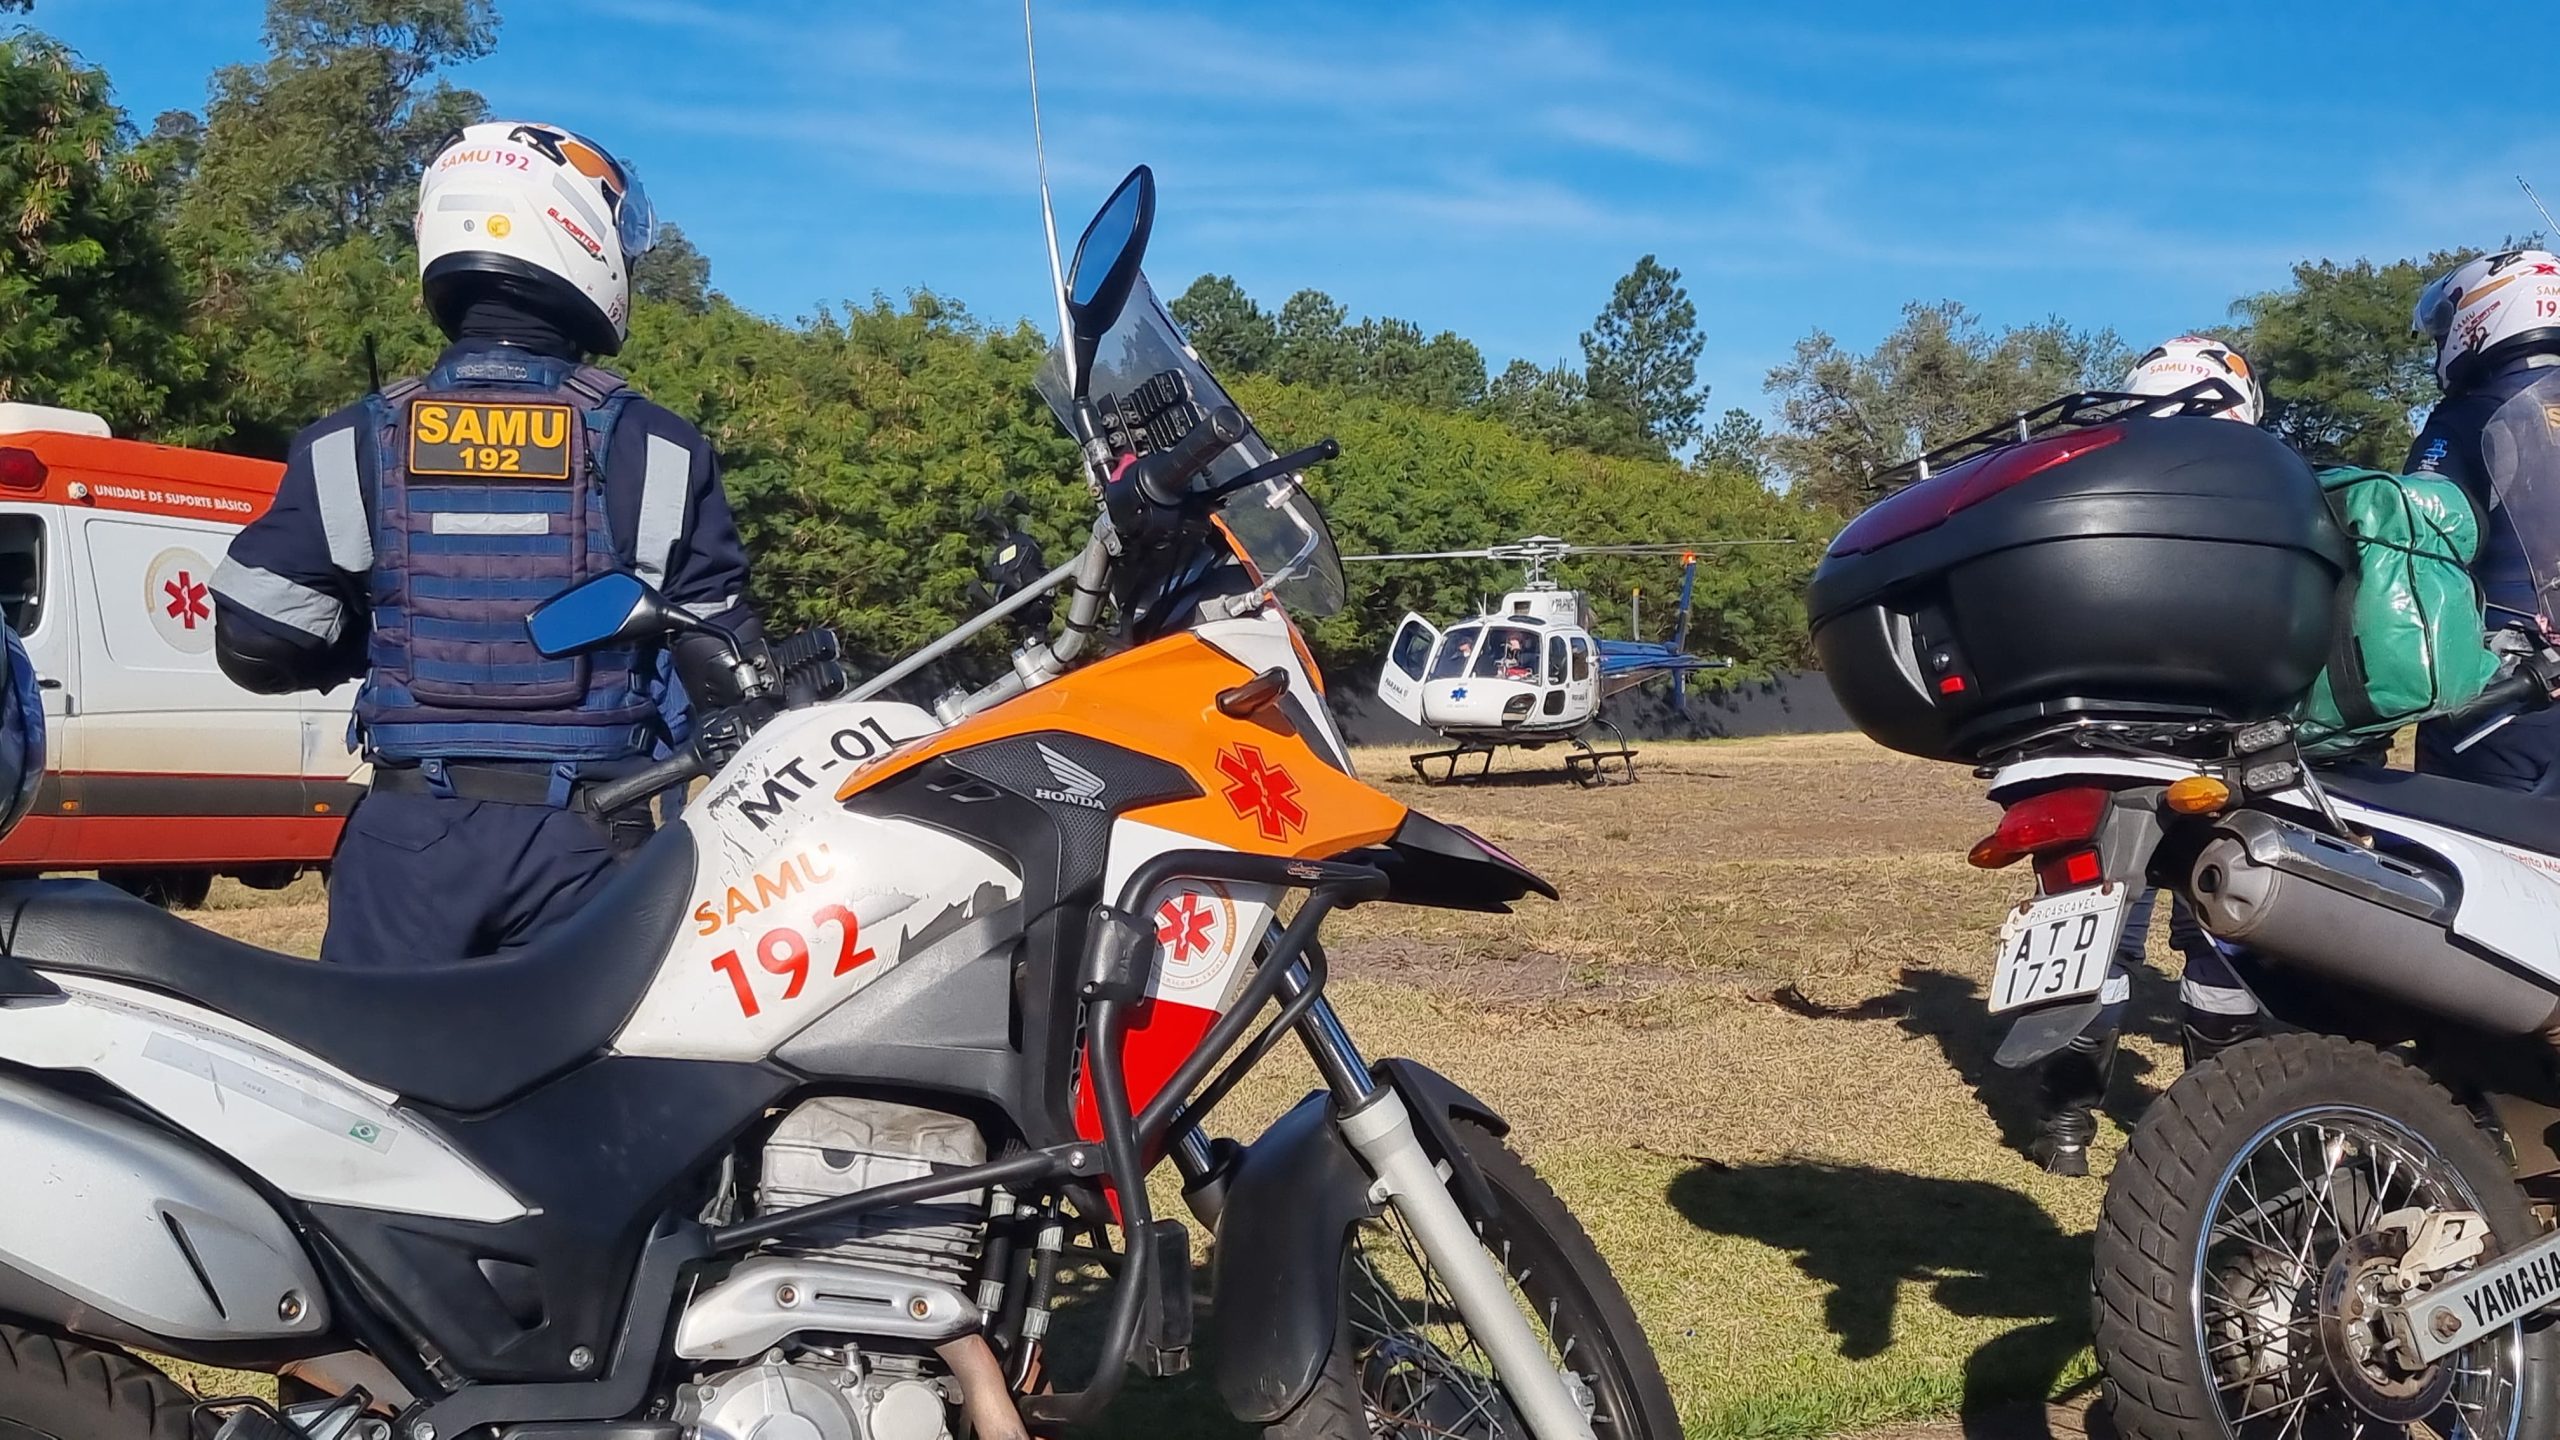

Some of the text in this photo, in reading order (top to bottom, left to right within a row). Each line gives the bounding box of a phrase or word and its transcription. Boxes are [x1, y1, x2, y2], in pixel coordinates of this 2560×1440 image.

[440, 150, 529, 172] SAMU 192
[547, 207, 601, 253] GLADIATOR
[2536, 284, 2560, 296] SAM
[2536, 300, 2560, 318] 19
[2149, 363, 2187, 375] SAMU
[417, 406, 565, 448] SAMU
[459, 447, 520, 471] 192
[94, 484, 253, 513] UNIDADE DE SUPORTE BÁSICO
[738, 716, 897, 832] MT-01
[1035, 788, 1107, 811] HONDA
[694, 843, 836, 937] SAMU
[2013, 913, 2099, 964] ATD
[710, 903, 877, 1018] 192
[2006, 953, 2088, 1004] 1731
[2463, 1251, 2560, 1327] YAMAHA
